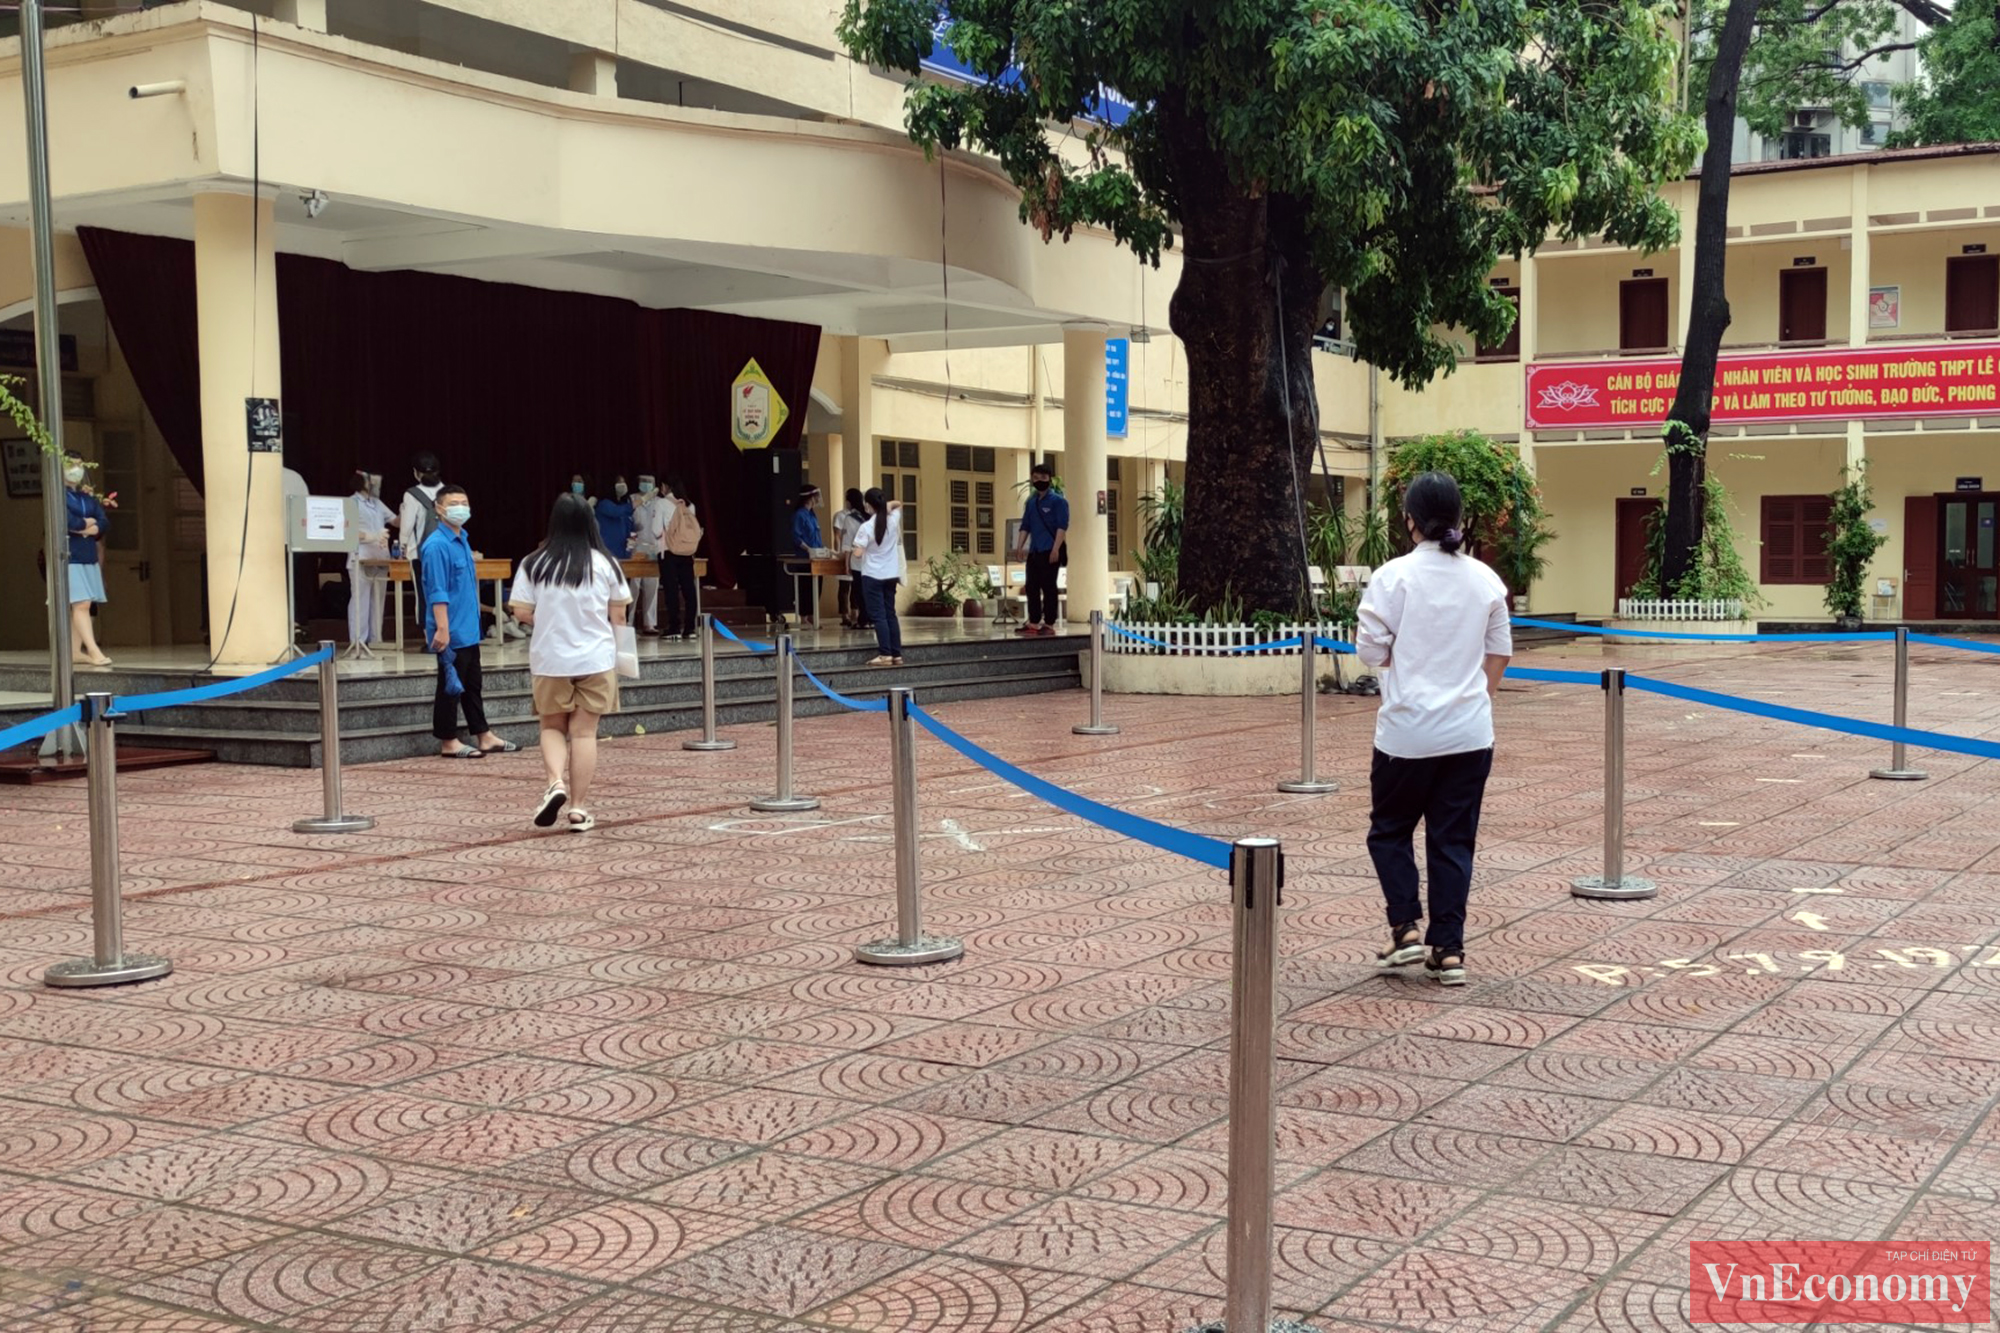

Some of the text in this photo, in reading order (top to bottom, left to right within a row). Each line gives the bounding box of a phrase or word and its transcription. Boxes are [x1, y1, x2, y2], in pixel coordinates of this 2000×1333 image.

[1607, 372, 1632, 391] CÁN
[1635, 371, 1652, 393] BỘ
[1723, 367, 1759, 386] NHÂN
[1762, 365, 1792, 385] VIÊN
[1795, 364, 1813, 383] VÀ
[1815, 366, 1842, 385] HỌC
[1846, 364, 1879, 381] SINH
[1882, 358, 1936, 379] TRƯỜNG
[1940, 360, 1974, 377] THPT
[1977, 355, 1994, 375] LÊ
[1610, 396, 1637, 415] TÍCH
[1640, 396, 1665, 416] CỰC
[1723, 391, 1740, 410] VÀ
[1743, 390, 1770, 410] LÀM
[1774, 392, 1807, 409] THEO
[1809, 390, 1828, 407] TƯ
[1829, 383, 1877, 406] TƯỞNG,
[1881, 387, 1909, 408] ĐẠO
[1912, 382, 1944, 404] ĐỨC,
[1948, 384, 1996, 403] PHONG
